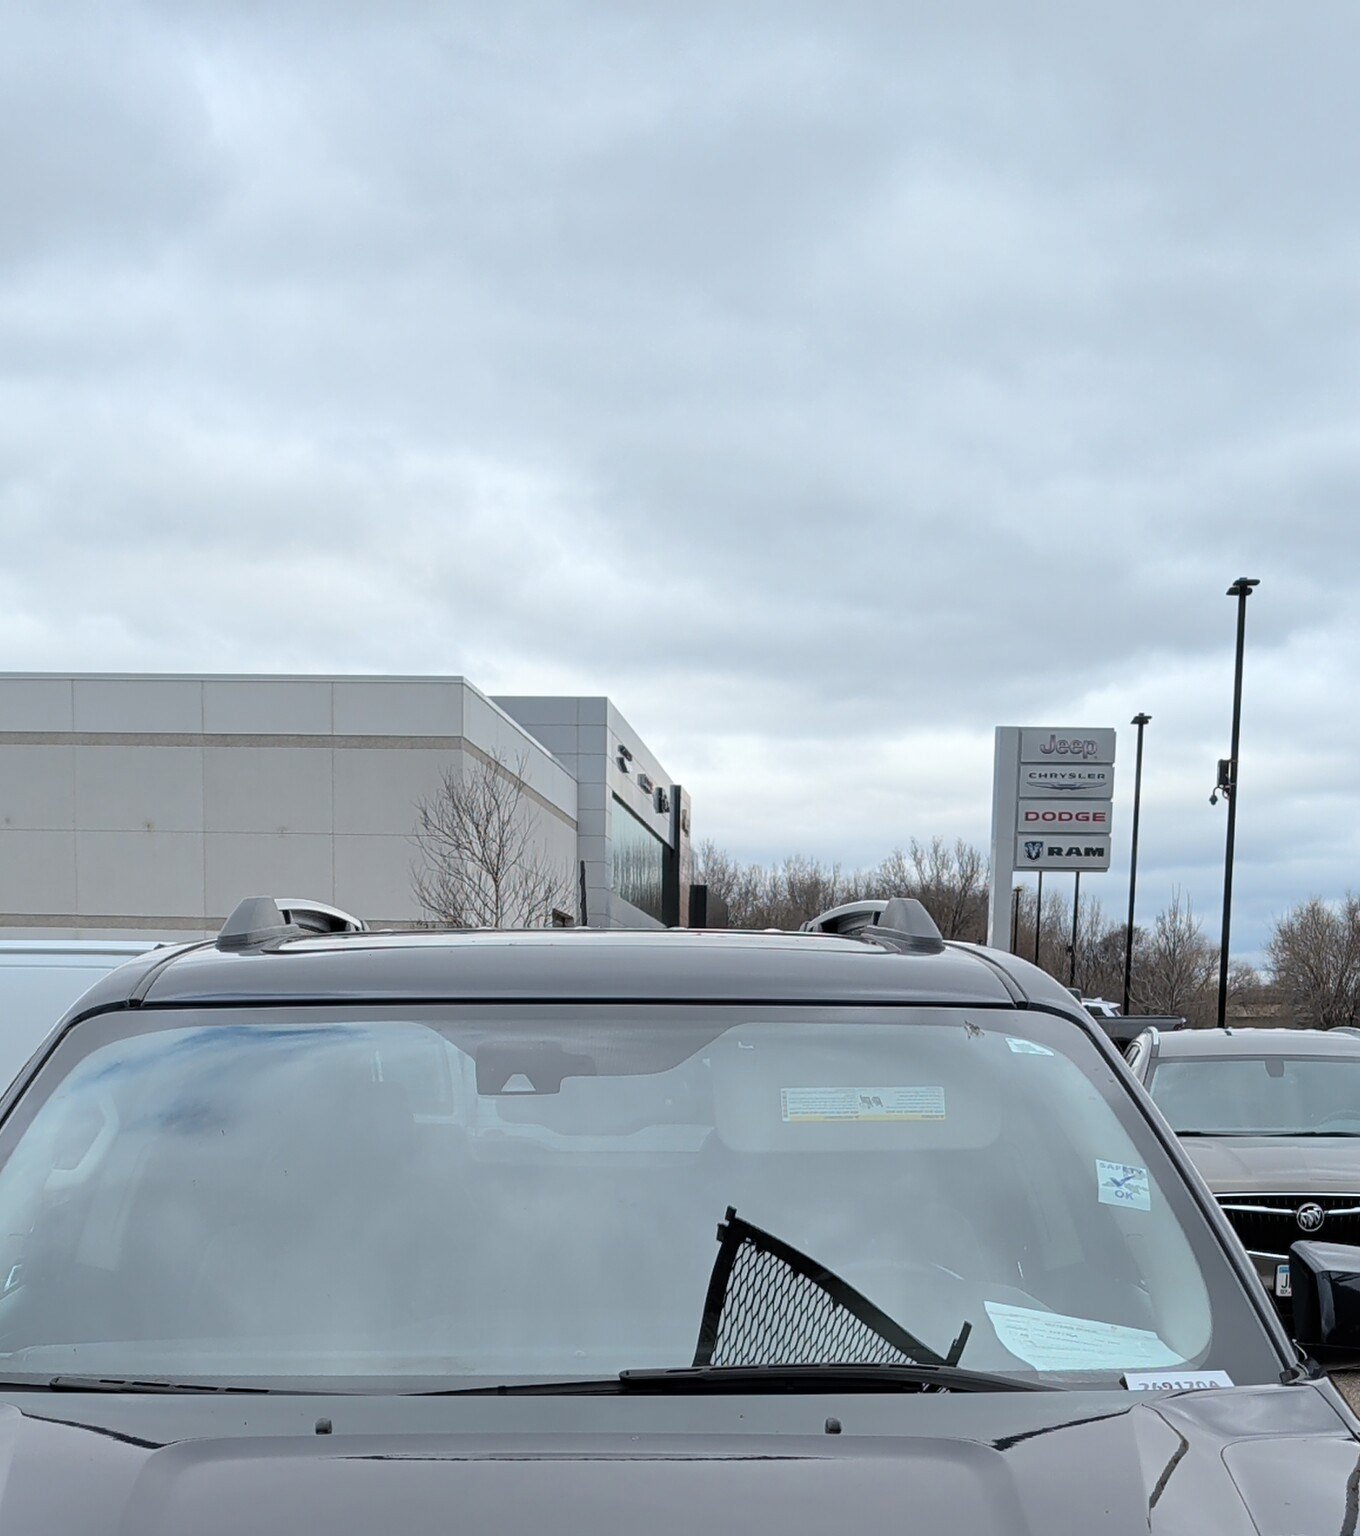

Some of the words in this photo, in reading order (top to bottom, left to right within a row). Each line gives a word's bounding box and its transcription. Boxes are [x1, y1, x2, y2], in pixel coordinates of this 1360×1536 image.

[1040, 735, 1098, 759] Jeep
[1028, 772, 1105, 780] CHRYSLER
[1024, 811, 1106, 822] DODGE
[1047, 846, 1104, 857] RAM
[1114, 1189, 1134, 1201] OK
